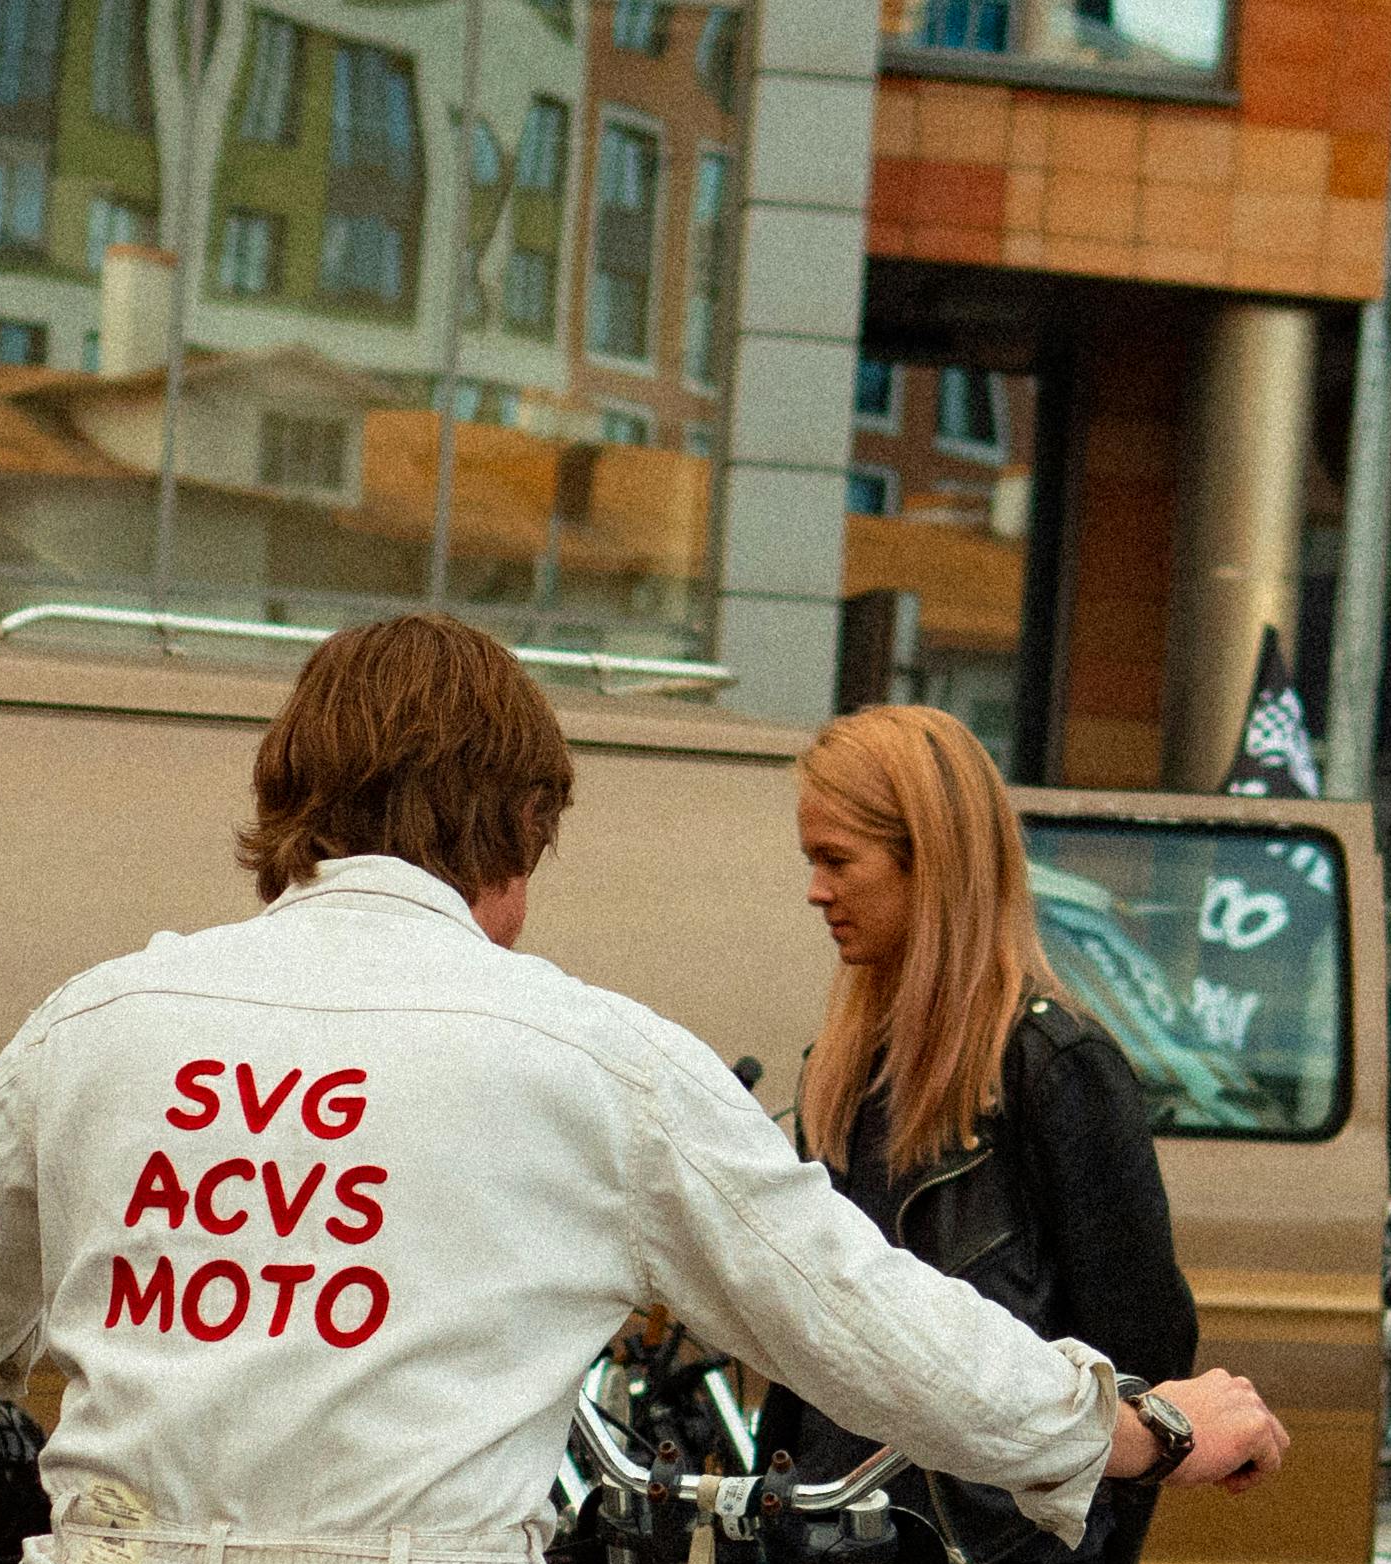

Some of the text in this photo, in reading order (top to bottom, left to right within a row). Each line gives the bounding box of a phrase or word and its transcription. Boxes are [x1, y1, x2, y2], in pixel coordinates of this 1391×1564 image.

[166, 1059, 367, 1140] SVG
[124, 1150, 388, 1245] ACVS
[104, 1255, 390, 1349] MOTO
